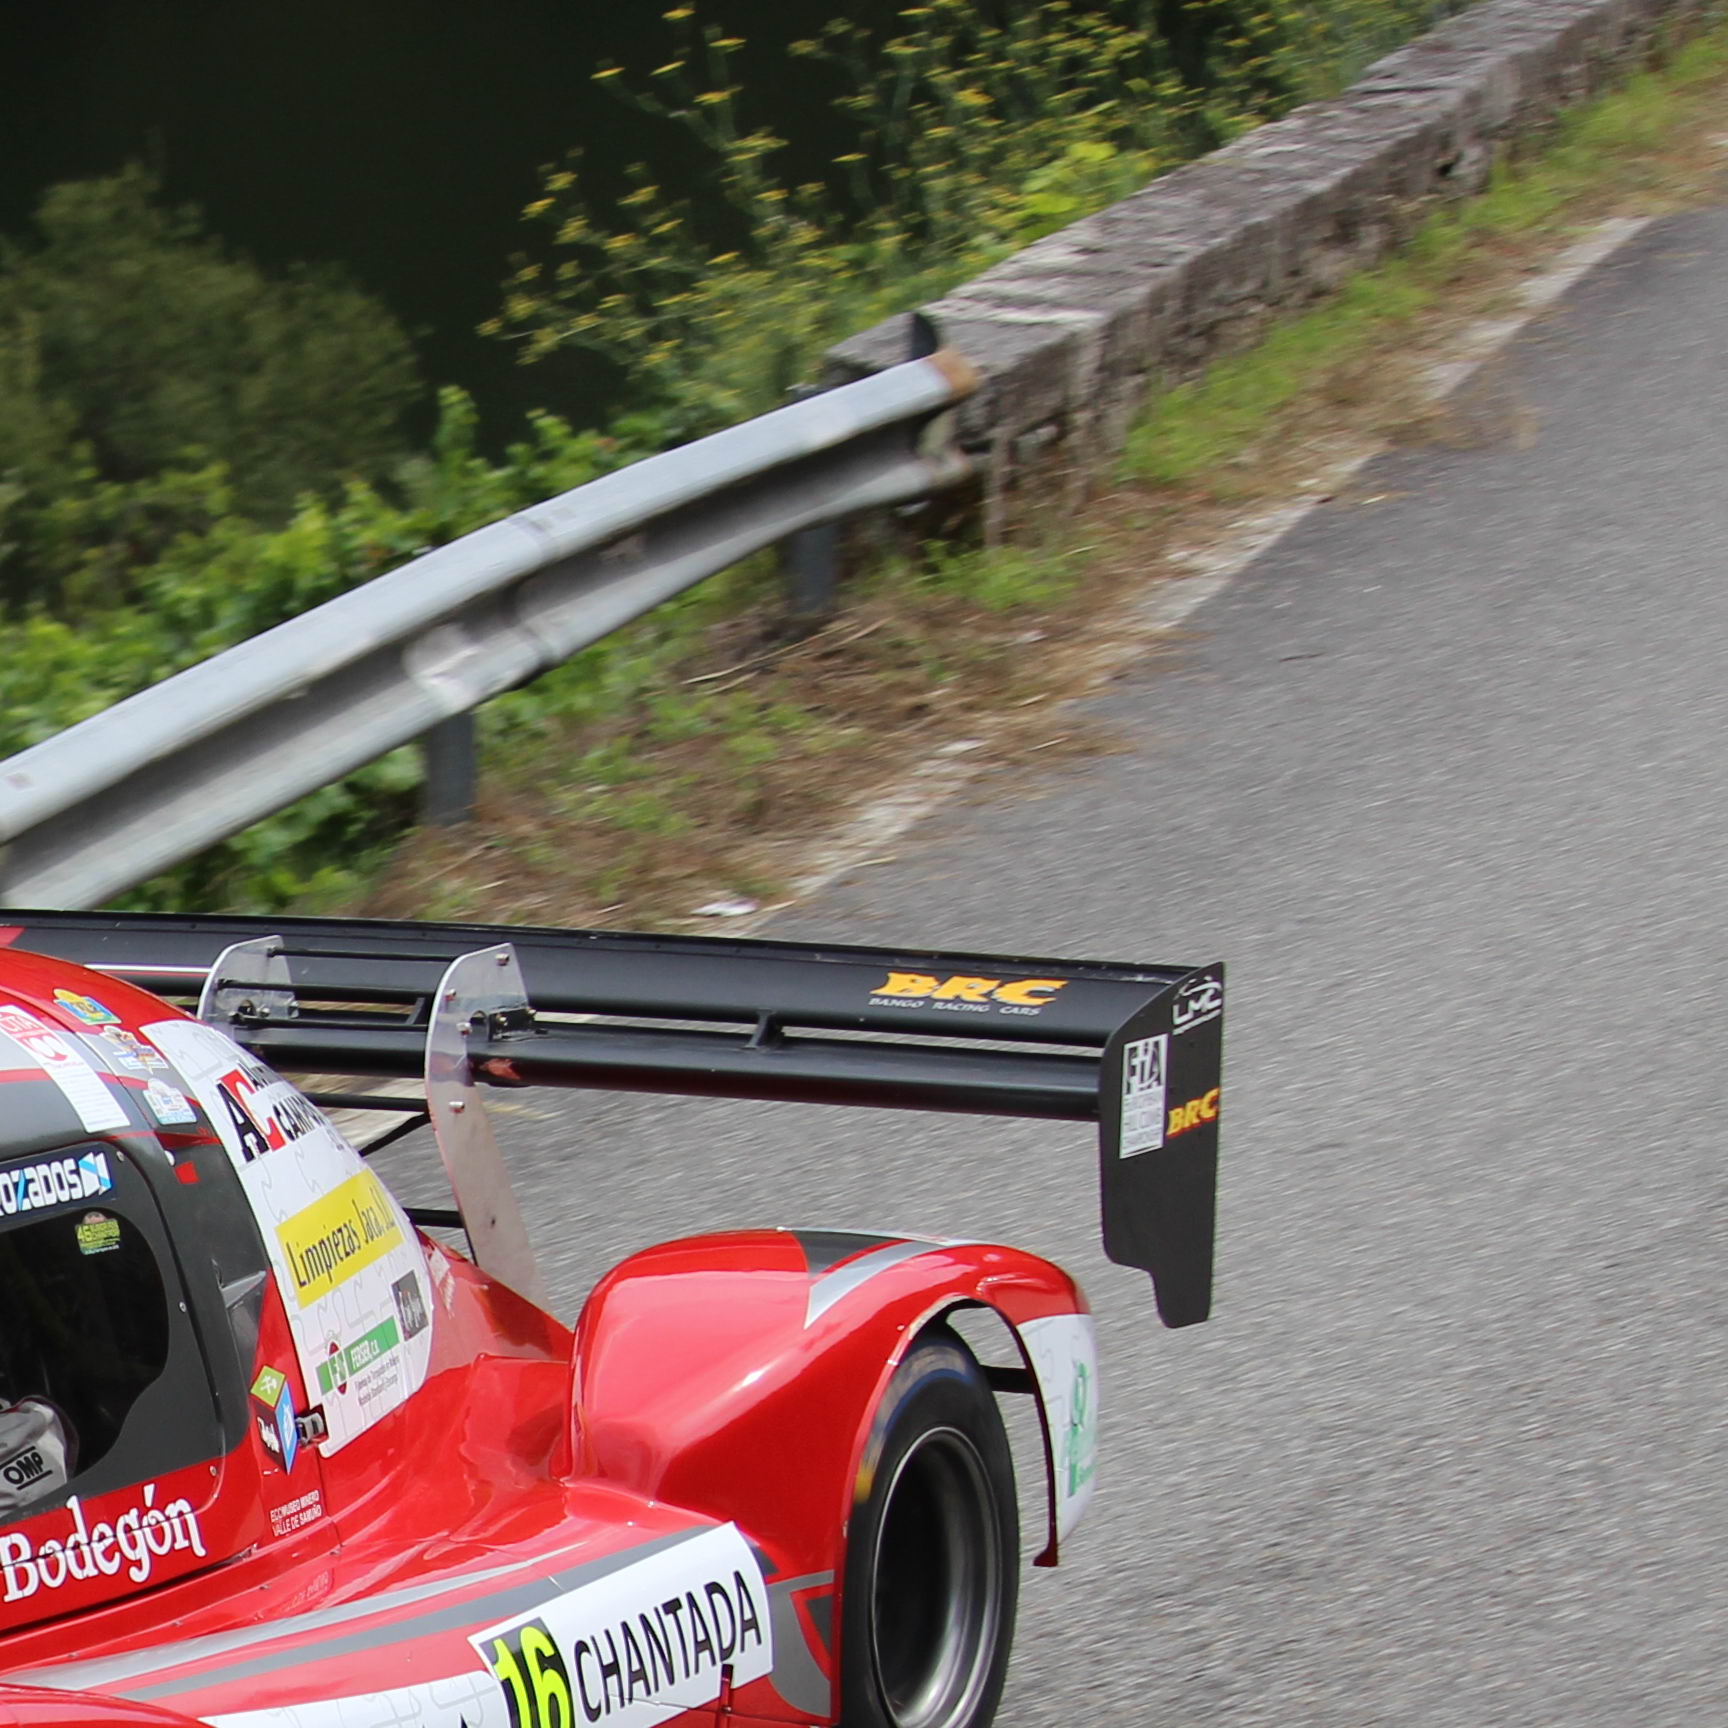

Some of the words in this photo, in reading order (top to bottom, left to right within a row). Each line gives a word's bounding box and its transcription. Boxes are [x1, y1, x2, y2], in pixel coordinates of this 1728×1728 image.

[869, 971, 1069, 1006] BRC
[931, 1001, 990, 1013] RACING
[999, 1005, 1040, 1016] CARS
[1166, 1087, 1221, 1139] BRC
[286, 1219, 362, 1289] Limpiezas
[3, 1451, 44, 1485] OMP
[574, 1570, 763, 1723] CHANTADA
